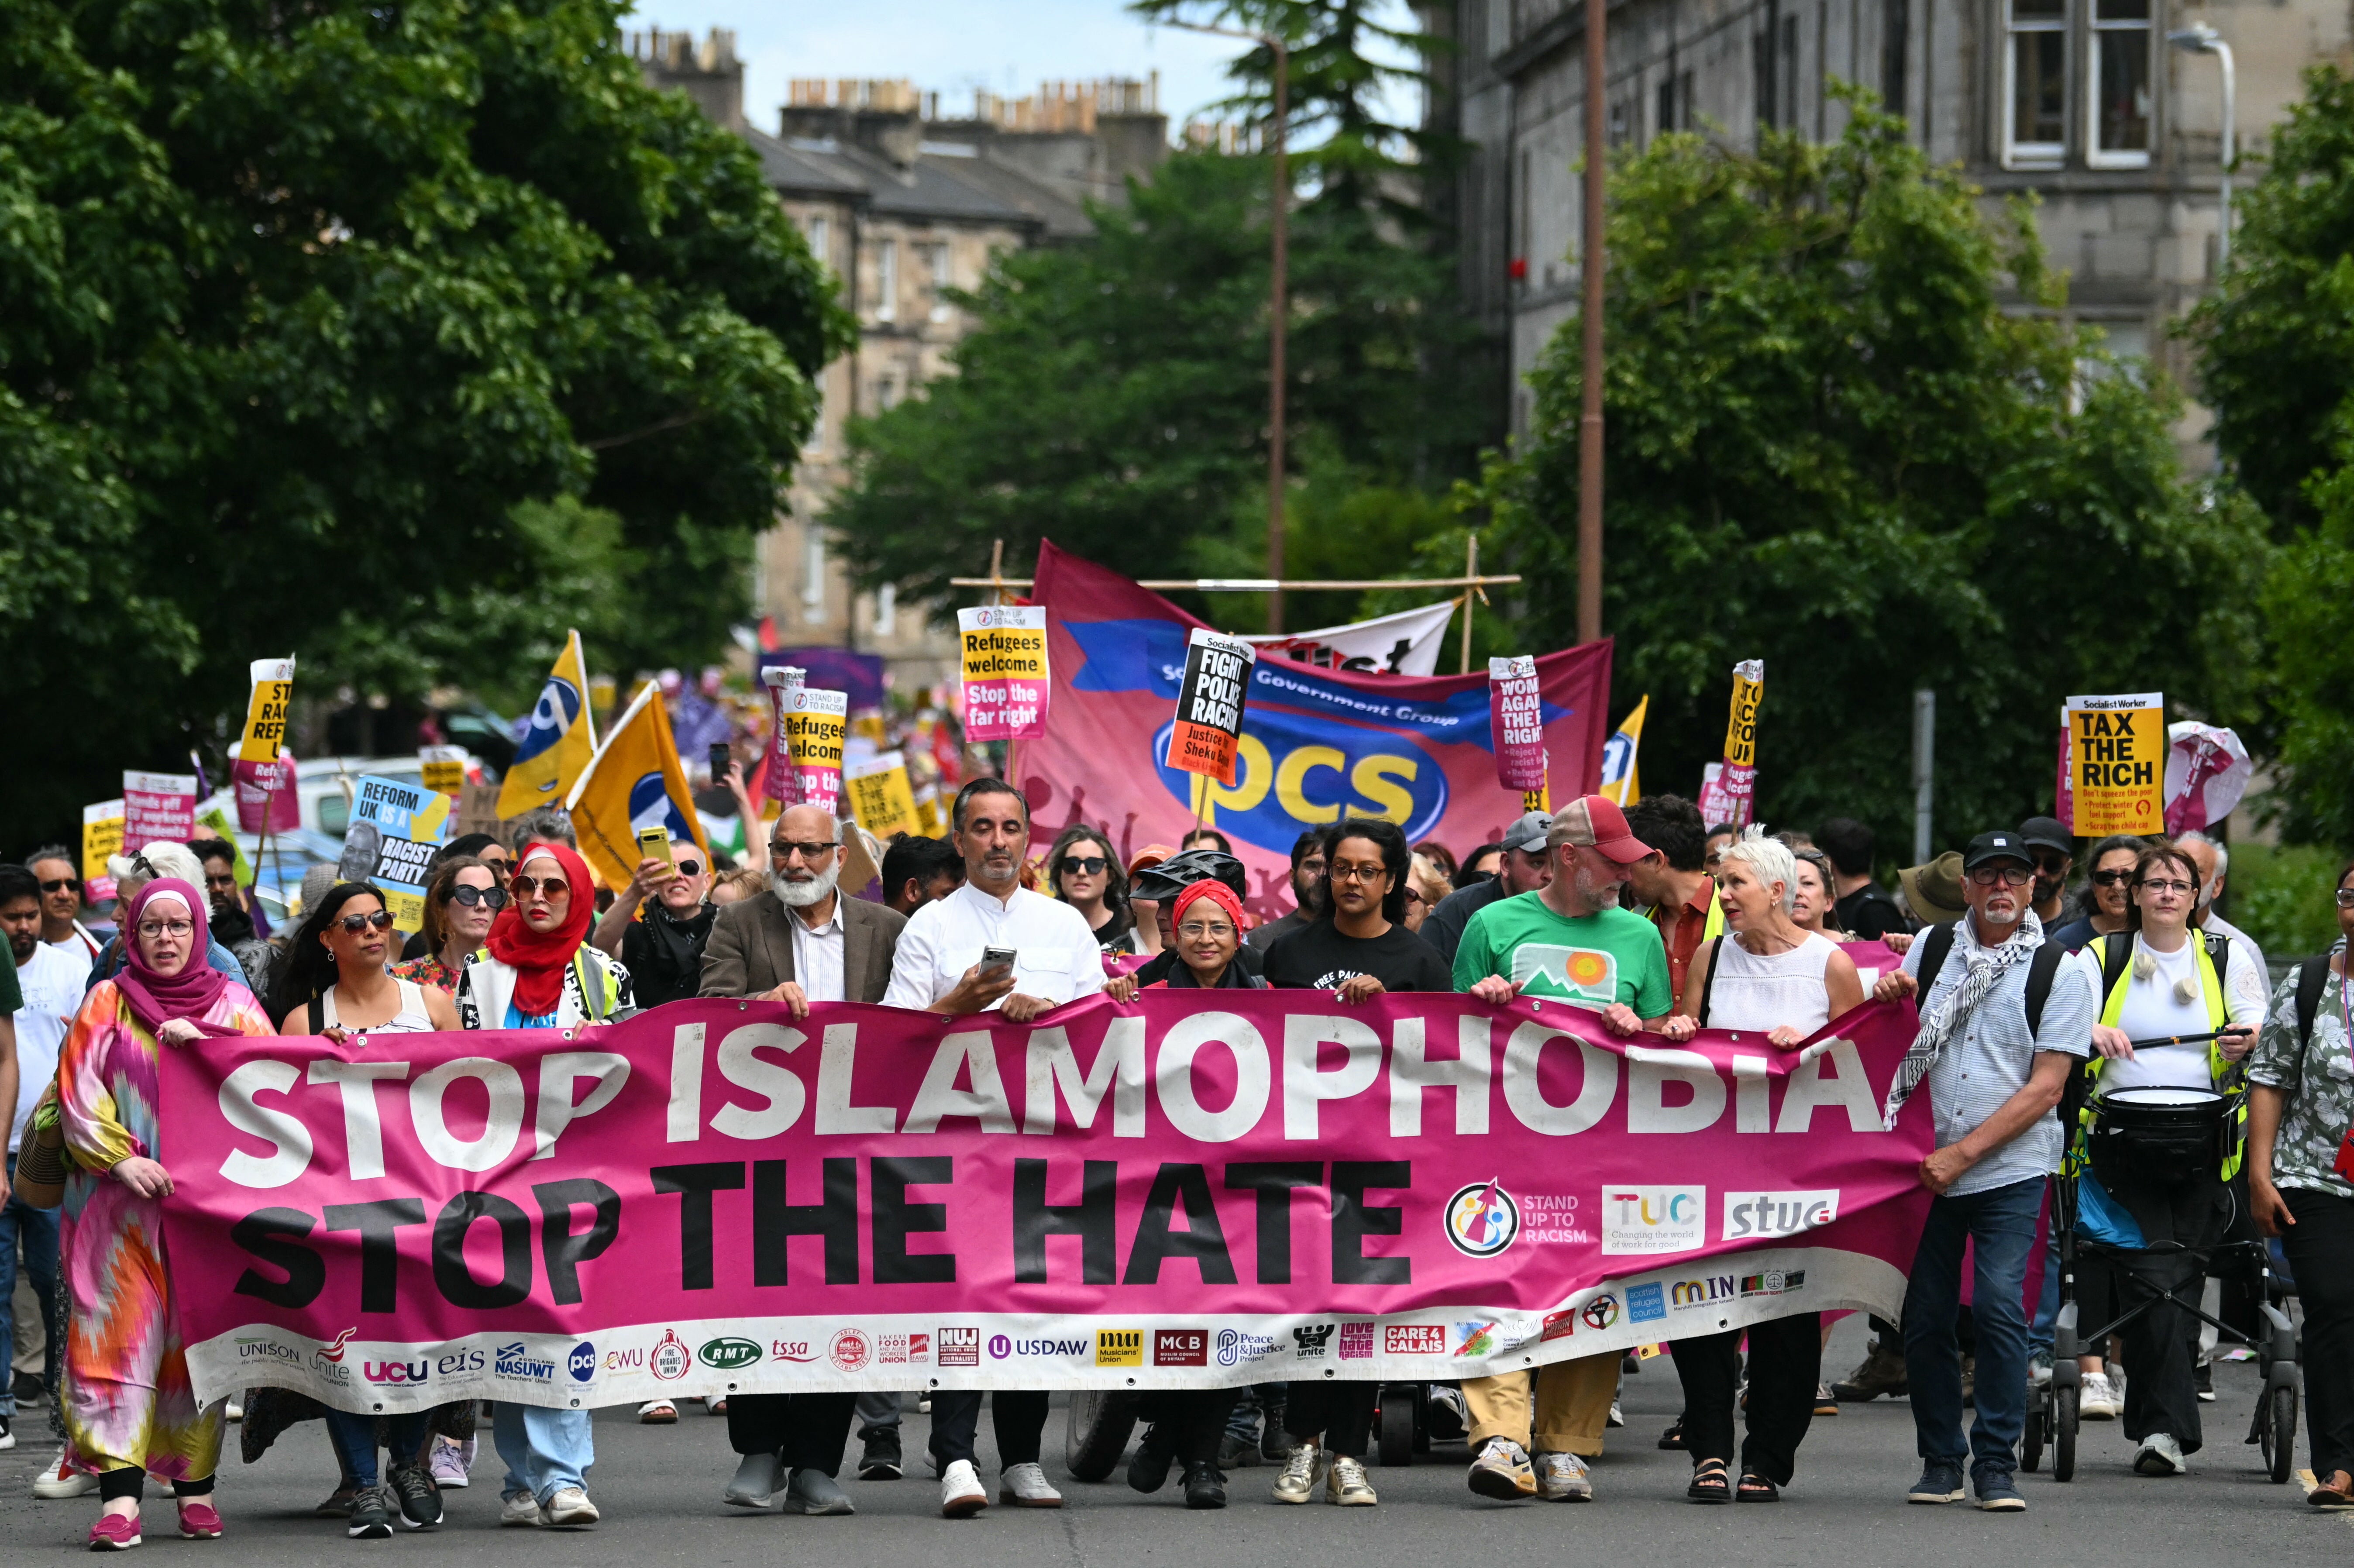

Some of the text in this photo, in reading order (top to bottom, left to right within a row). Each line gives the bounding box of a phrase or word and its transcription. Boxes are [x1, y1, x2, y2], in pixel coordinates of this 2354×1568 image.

[966, 633, 1041, 653] Refugees
[1208, 638, 1240, 654] Socialist
[968, 656, 1038, 673] welcome
[1200, 649, 1243, 682] FIGHT
[1195, 673, 1241, 709] POLICE
[1500, 677, 1539, 696] WOM
[810, 694, 830, 703] STAND
[968, 684, 1038, 706] Stop the
[1256, 669, 1459, 727] Government Group
[821, 703, 845, 713] RACISM
[2084, 700, 2117, 708] Socialist
[970, 705, 1037, 728] far right
[1191, 697, 1239, 735] RACISM
[1502, 712, 1534, 729] THE
[2079, 713, 2135, 736] TAX
[1187, 726, 1222, 746] Justice
[1185, 741, 1216, 760] Sheku
[1510, 747, 1536, 757] Reject
[2080, 738, 2134, 761] THE
[1190, 732, 1418, 826] pcs
[2082, 762, 2153, 787] RICH
[363, 782, 419, 812] REFORM
[2083, 788, 2099, 797] Don't
[2101, 789, 2125, 798] squeeze
[2140, 788, 2153, 797] poor
[2089, 800, 2111, 809] Protect
[359, 800, 408, 829] UK IS A
[2103, 812, 2126, 820] support
[2090, 821, 2149, 831] Scrap two child cap
[381, 837, 436, 866] RACIST
[377, 858, 427, 885] PARTY
[1226, 864, 1240, 876] SMITH
[1313, 972, 1335, 990] FREE
[218, 1010, 1886, 1189] STOP ISLAMOPHOBIA
[1524, 1196, 1579, 1210] STAND
[1612, 1193, 1697, 1226] TUC
[1525, 1212, 1575, 1227] UP TO
[232, 1155, 1412, 1314] STOP THE HATE
[1525, 1229, 1587, 1244] RACISM
[1611, 1230, 1694, 1240] Changing the world
[1611, 1240, 1621, 1248] of
[1645, 1240, 1656, 1248] for
[1658, 1240, 1680, 1249] good
[1629, 1287, 1659, 1299] scottish
[1631, 1298, 1661, 1309] refugee
[1693, 1301, 1718, 1309] Integration
[1632, 1307, 1662, 1318] council
[940, 1329, 977, 1345] NUJ
[1101, 1333, 1139, 1347] mu
[1240, 1334, 1273, 1344] Peace
[1387, 1327, 1440, 1340] CARE 4
[1548, 1328, 1570, 1339] HOUSING
[772, 1339, 808, 1356] tssa
[993, 1339, 1088, 1356] U USDAW
[1160, 1336, 1201, 1350] MCB
[1387, 1340, 1443, 1352] CALAIS
[240, 1343, 299, 1362] UNISON
[607, 1348, 643, 1370] CWU
[712, 1347, 749, 1360] RMT
[1240, 1355, 1265, 1363] Project
[1297, 1347, 1325, 1357] unite
[270, 1358, 289, 1367] service
[289, 1363, 306, 1372] union
[438, 1347, 485, 1375] eis
[518, 1357, 555, 1365] SCOTLAND
[570, 1354, 595, 1372] pcs
[659, 1357, 681, 1366] BRIGADES
[448, 1372, 475, 1380] Educational
[495, 1361, 555, 1379] NASUWT
[663, 1366, 677, 1375] UNION
[507, 1375, 533, 1383] Teachers'
